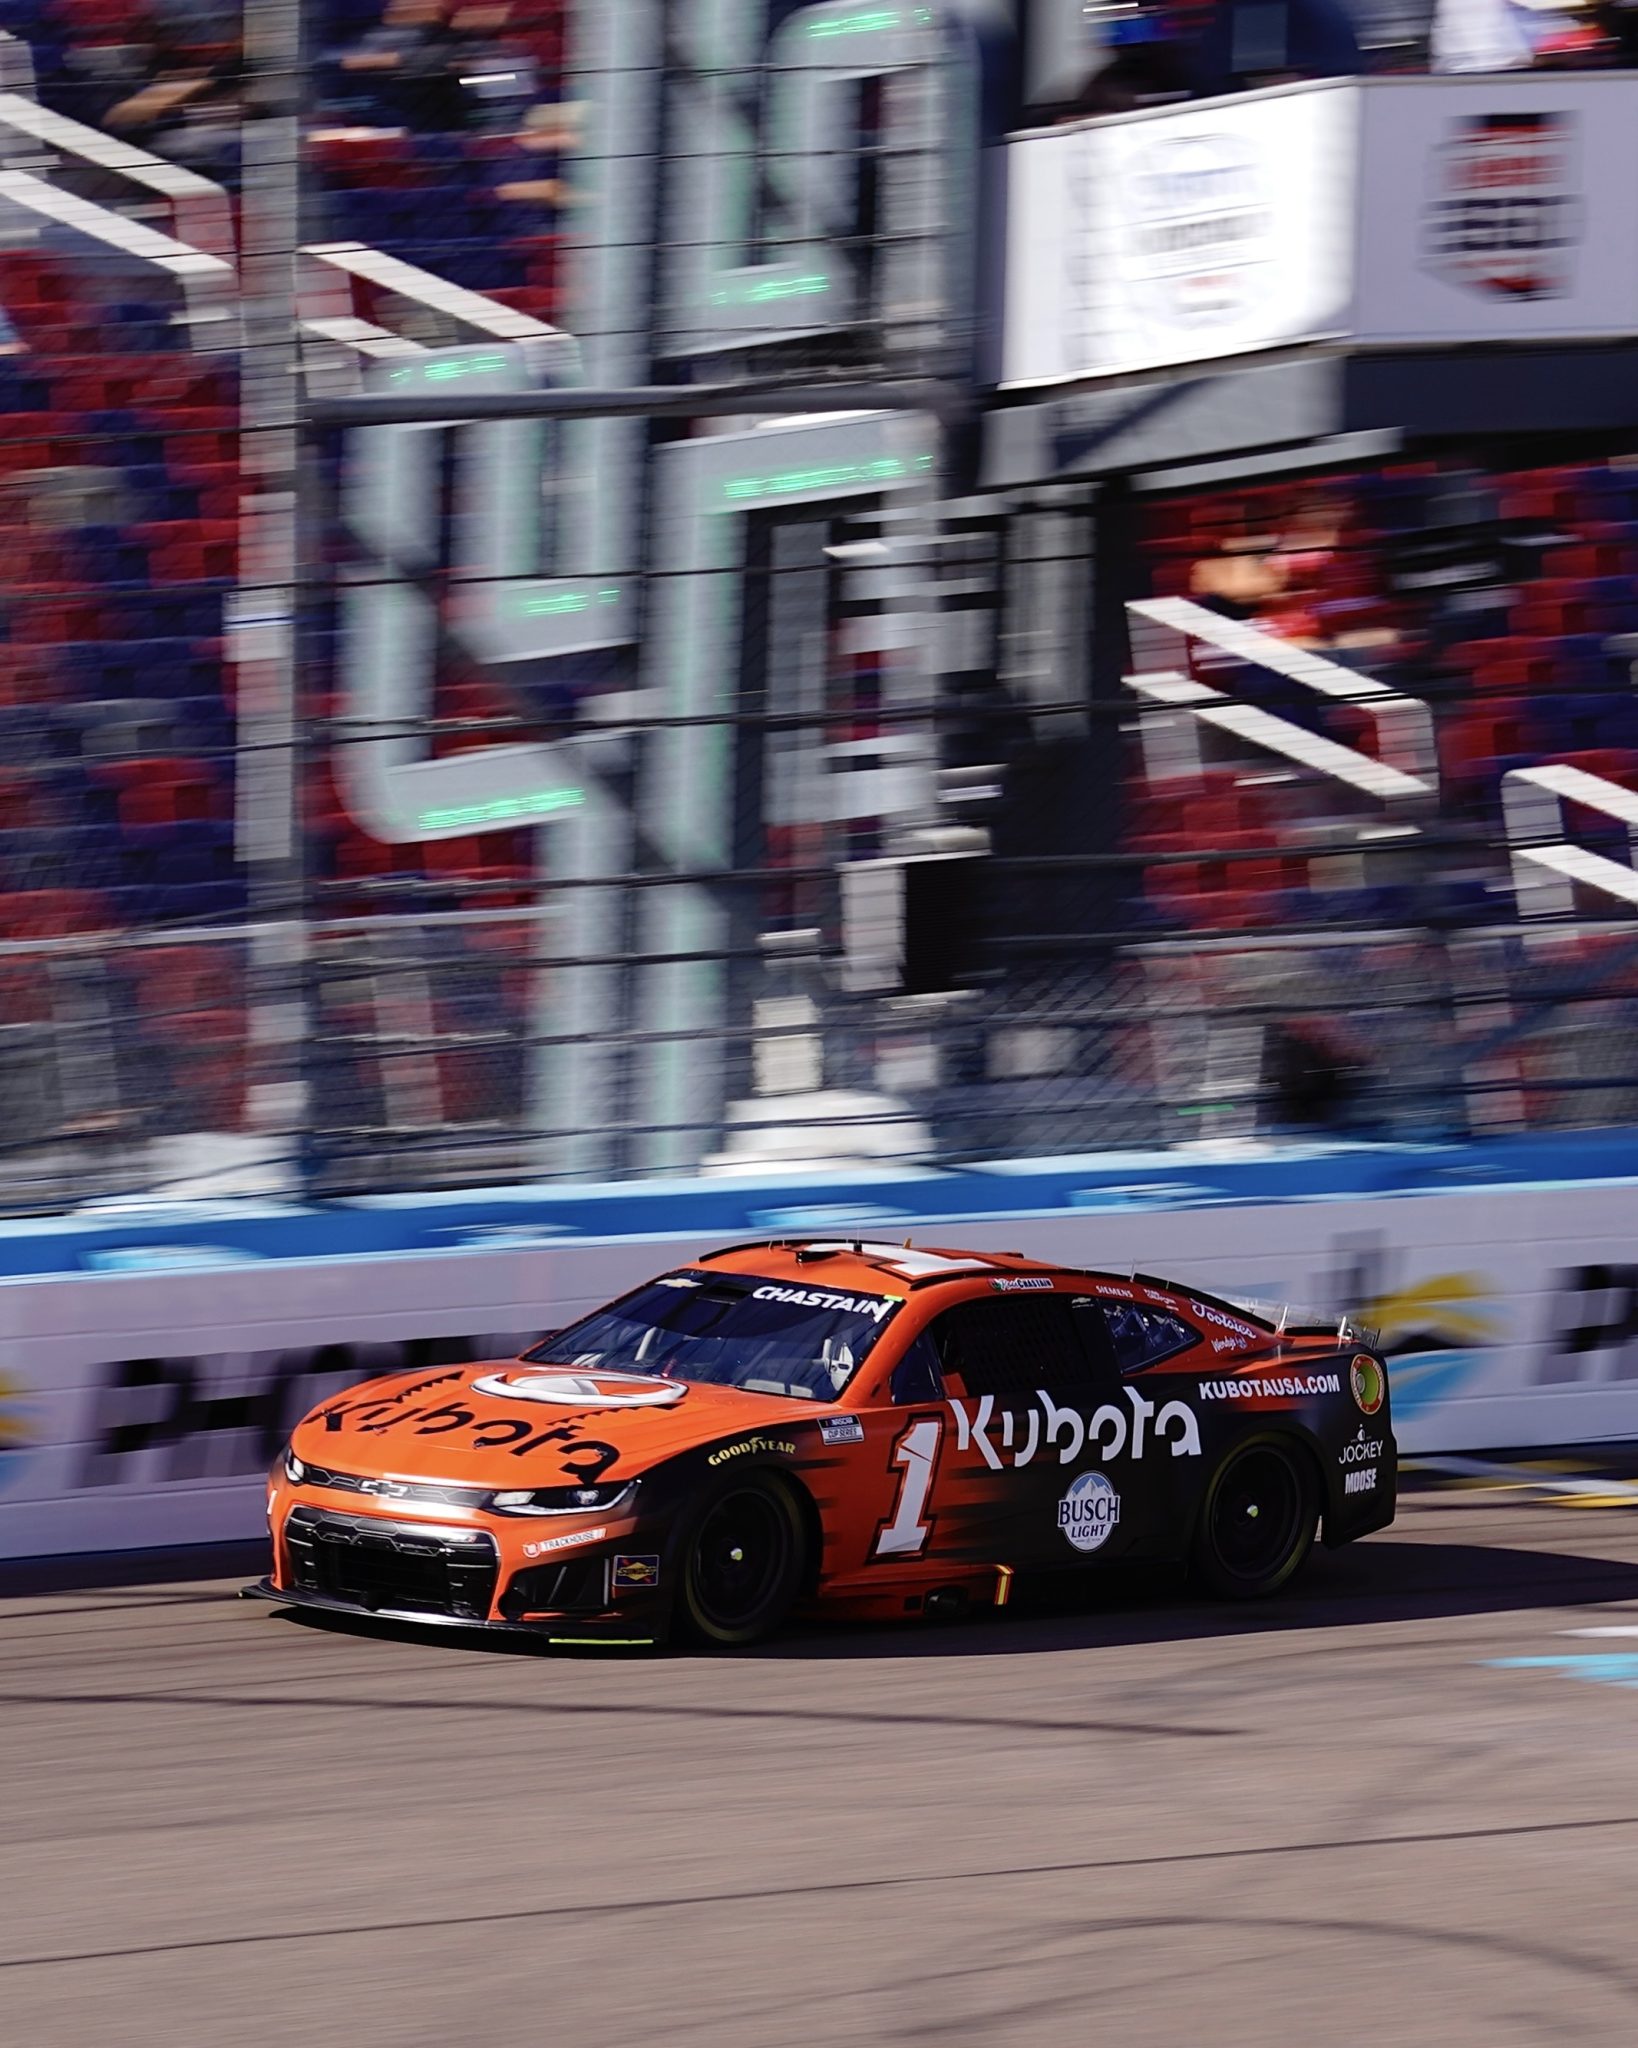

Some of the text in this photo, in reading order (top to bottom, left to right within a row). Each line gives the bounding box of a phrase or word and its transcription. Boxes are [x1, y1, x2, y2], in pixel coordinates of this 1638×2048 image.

[752, 1285, 894, 1324] CHASTAIN
[1095, 1285, 1134, 1298] SIEMENS
[1189, 1298, 1257, 1339] Tootsies
[1198, 1374, 1341, 1400] KUBOTAUSA.COM
[947, 1385, 1203, 1470] Kubota
[708, 1436, 796, 1466] GOODYEAR
[1338, 1440, 1384, 1465] JOCKEY
[875, 1421, 939, 1555] 1
[1345, 1468, 1377, 1494] MOOSE
[1060, 1496, 1119, 1525] BUSCH
[543, 1533, 595, 1550] TRACKHOUSE
[1071, 1524, 1106, 1538] LIGHT
